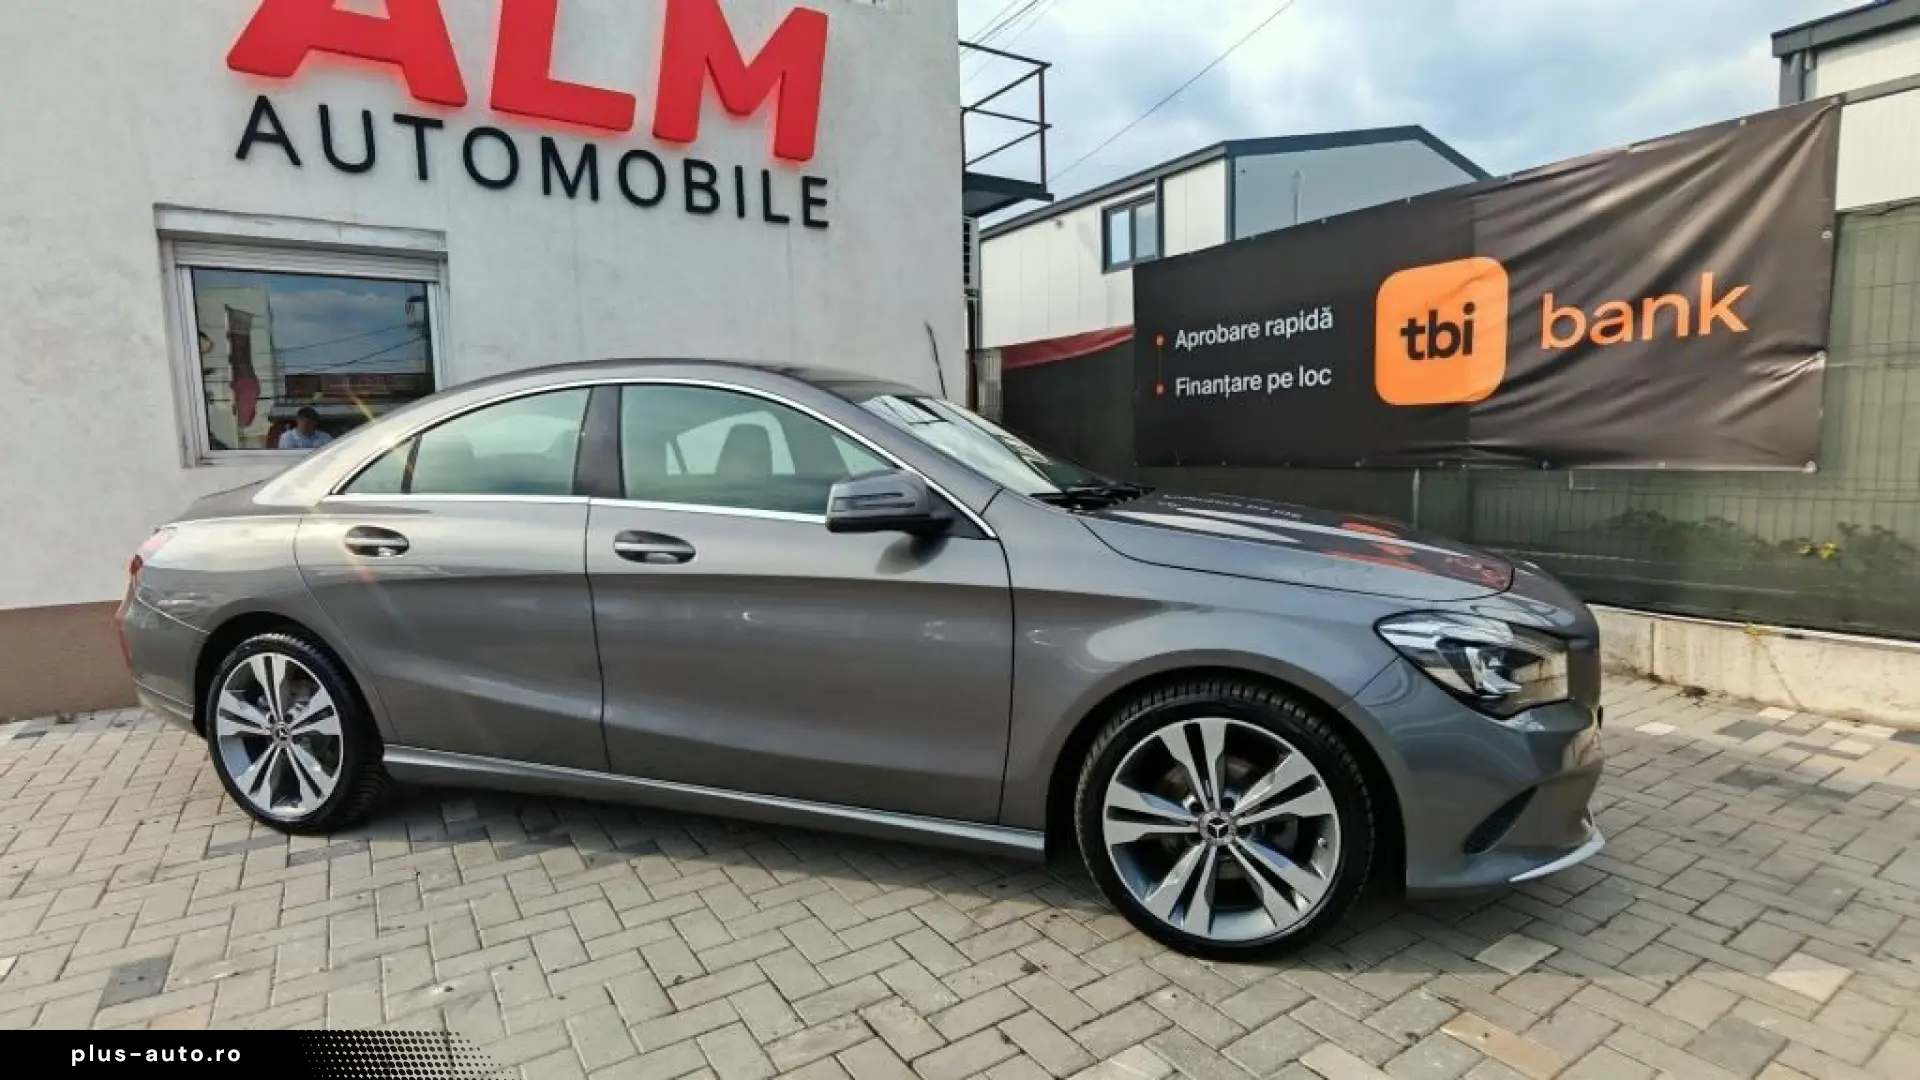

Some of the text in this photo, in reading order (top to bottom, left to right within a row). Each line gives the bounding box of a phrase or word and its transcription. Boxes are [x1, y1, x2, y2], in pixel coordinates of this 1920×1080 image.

[227, 0, 828, 164] ALM
[235, 95, 830, 229] AUTOMOBILE
[1174, 306, 1334, 351] Aprobare rapidă
[1400, 271, 1751, 361] tbi bank
[1174, 364, 1333, 399] Finanțare pe loc
